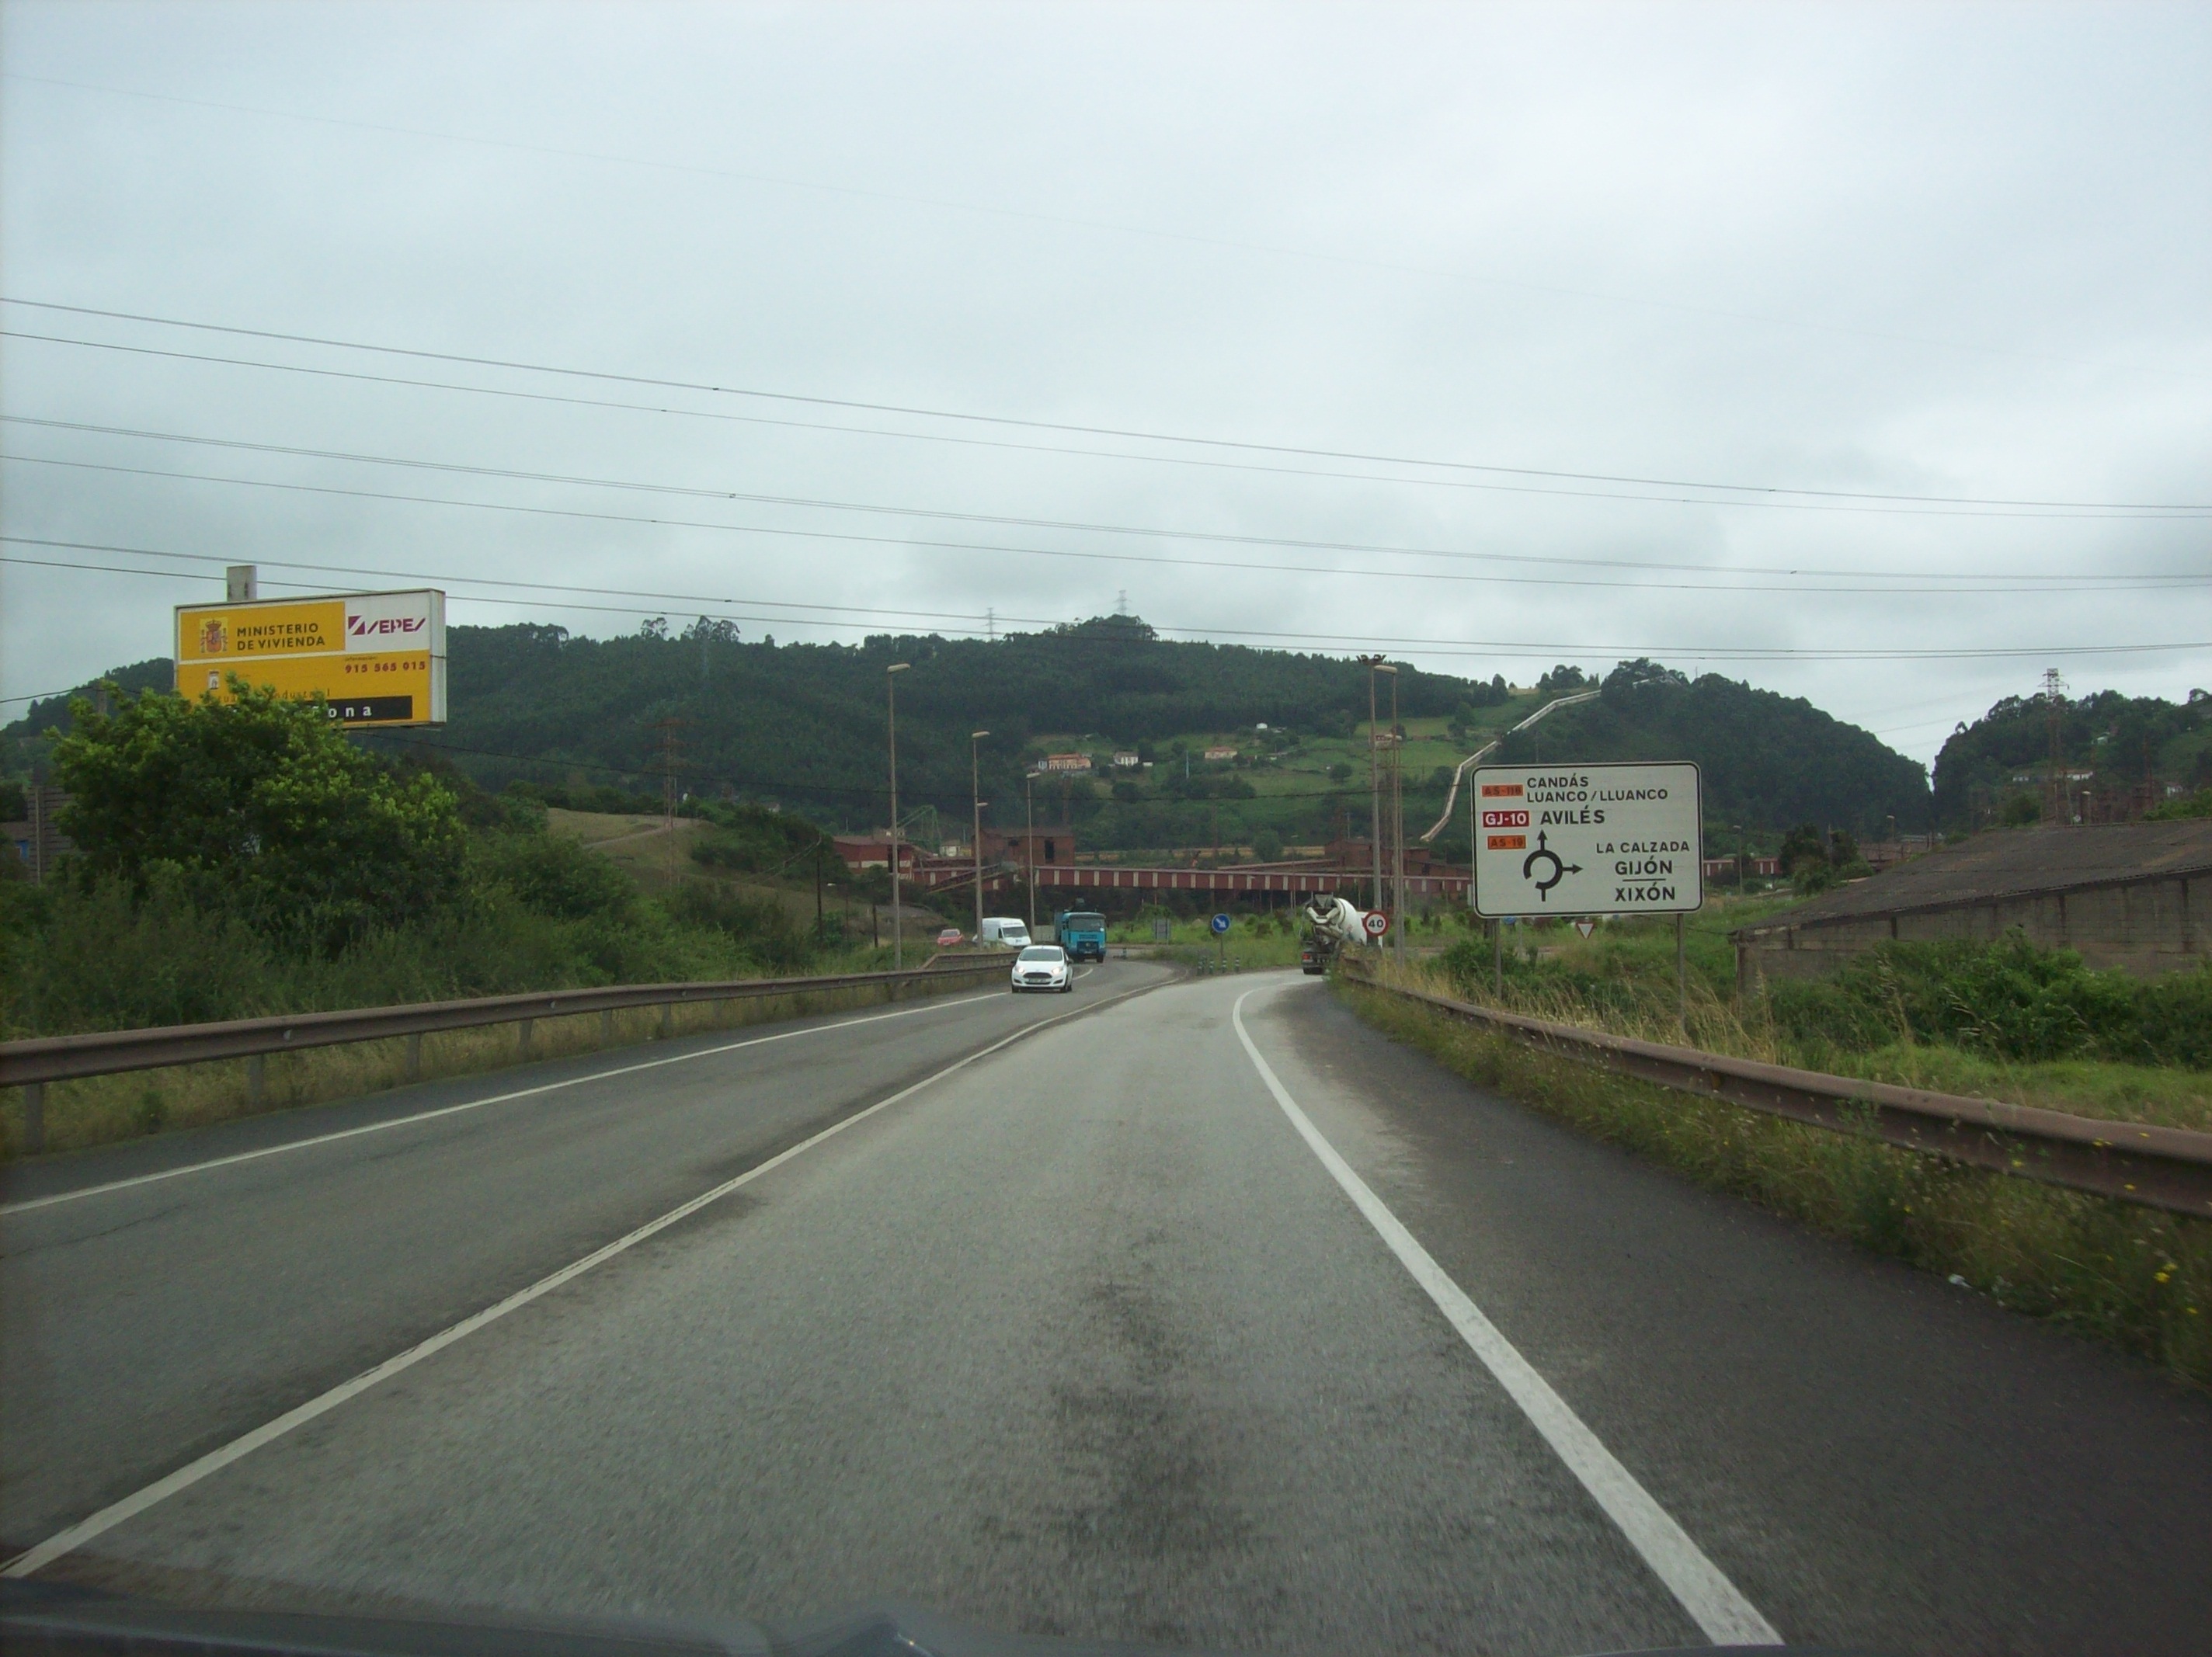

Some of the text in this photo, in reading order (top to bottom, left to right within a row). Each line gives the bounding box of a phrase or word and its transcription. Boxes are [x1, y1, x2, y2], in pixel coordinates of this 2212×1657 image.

[236, 622, 319, 637] MINISTERIO
[237, 635, 325, 651] DE VIVIENDA
[345, 663, 367, 674] 915
[402, 661, 426, 671] 015
[1526, 773, 1589, 789] CANDÁS
[1485, 805, 1605, 825] GJ-10 AVILÉS
[1596, 841, 1690, 854] LA CALZADA
[1615, 856, 1673, 876] GIJÓN
[1615, 882, 1676, 902] XIXÓN
[1368, 919, 1384, 928] 40
